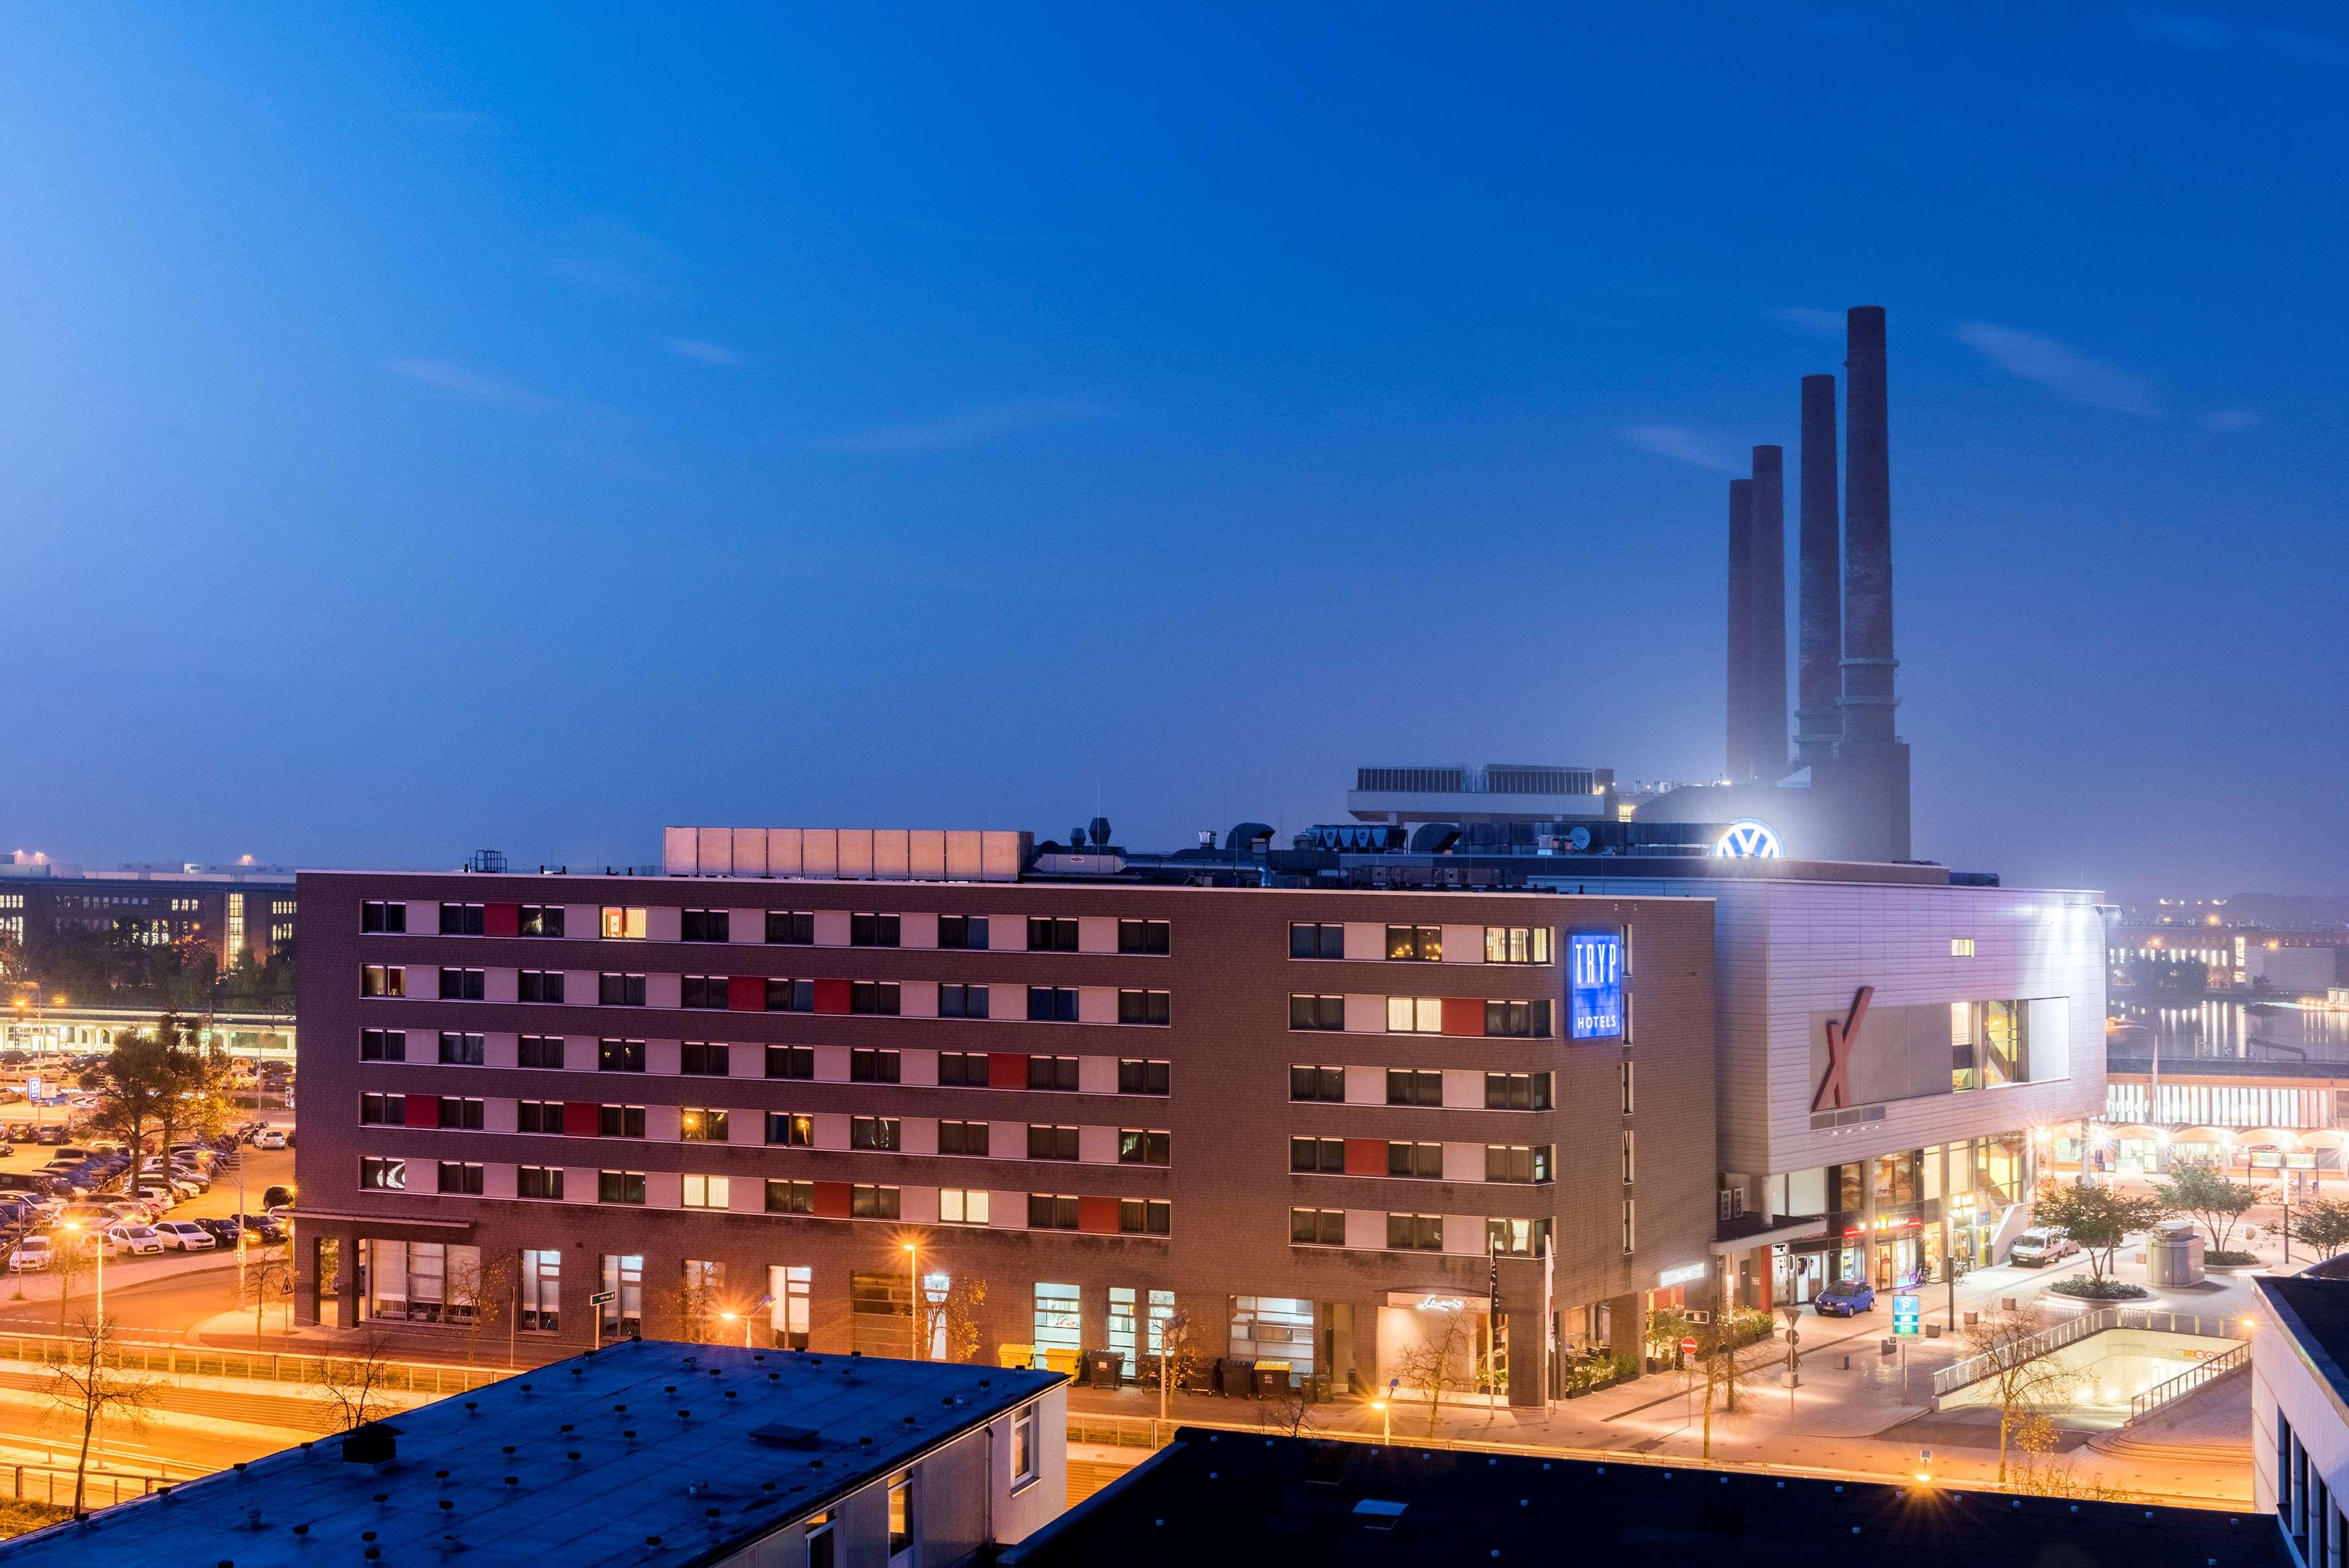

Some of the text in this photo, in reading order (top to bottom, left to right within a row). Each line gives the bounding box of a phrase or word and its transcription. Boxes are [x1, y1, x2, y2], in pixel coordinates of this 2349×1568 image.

[1575, 943, 1616, 984] TRYP
[1577, 1015, 1616, 1030] HOTELS
[1902, 1301, 1910, 1311] P
